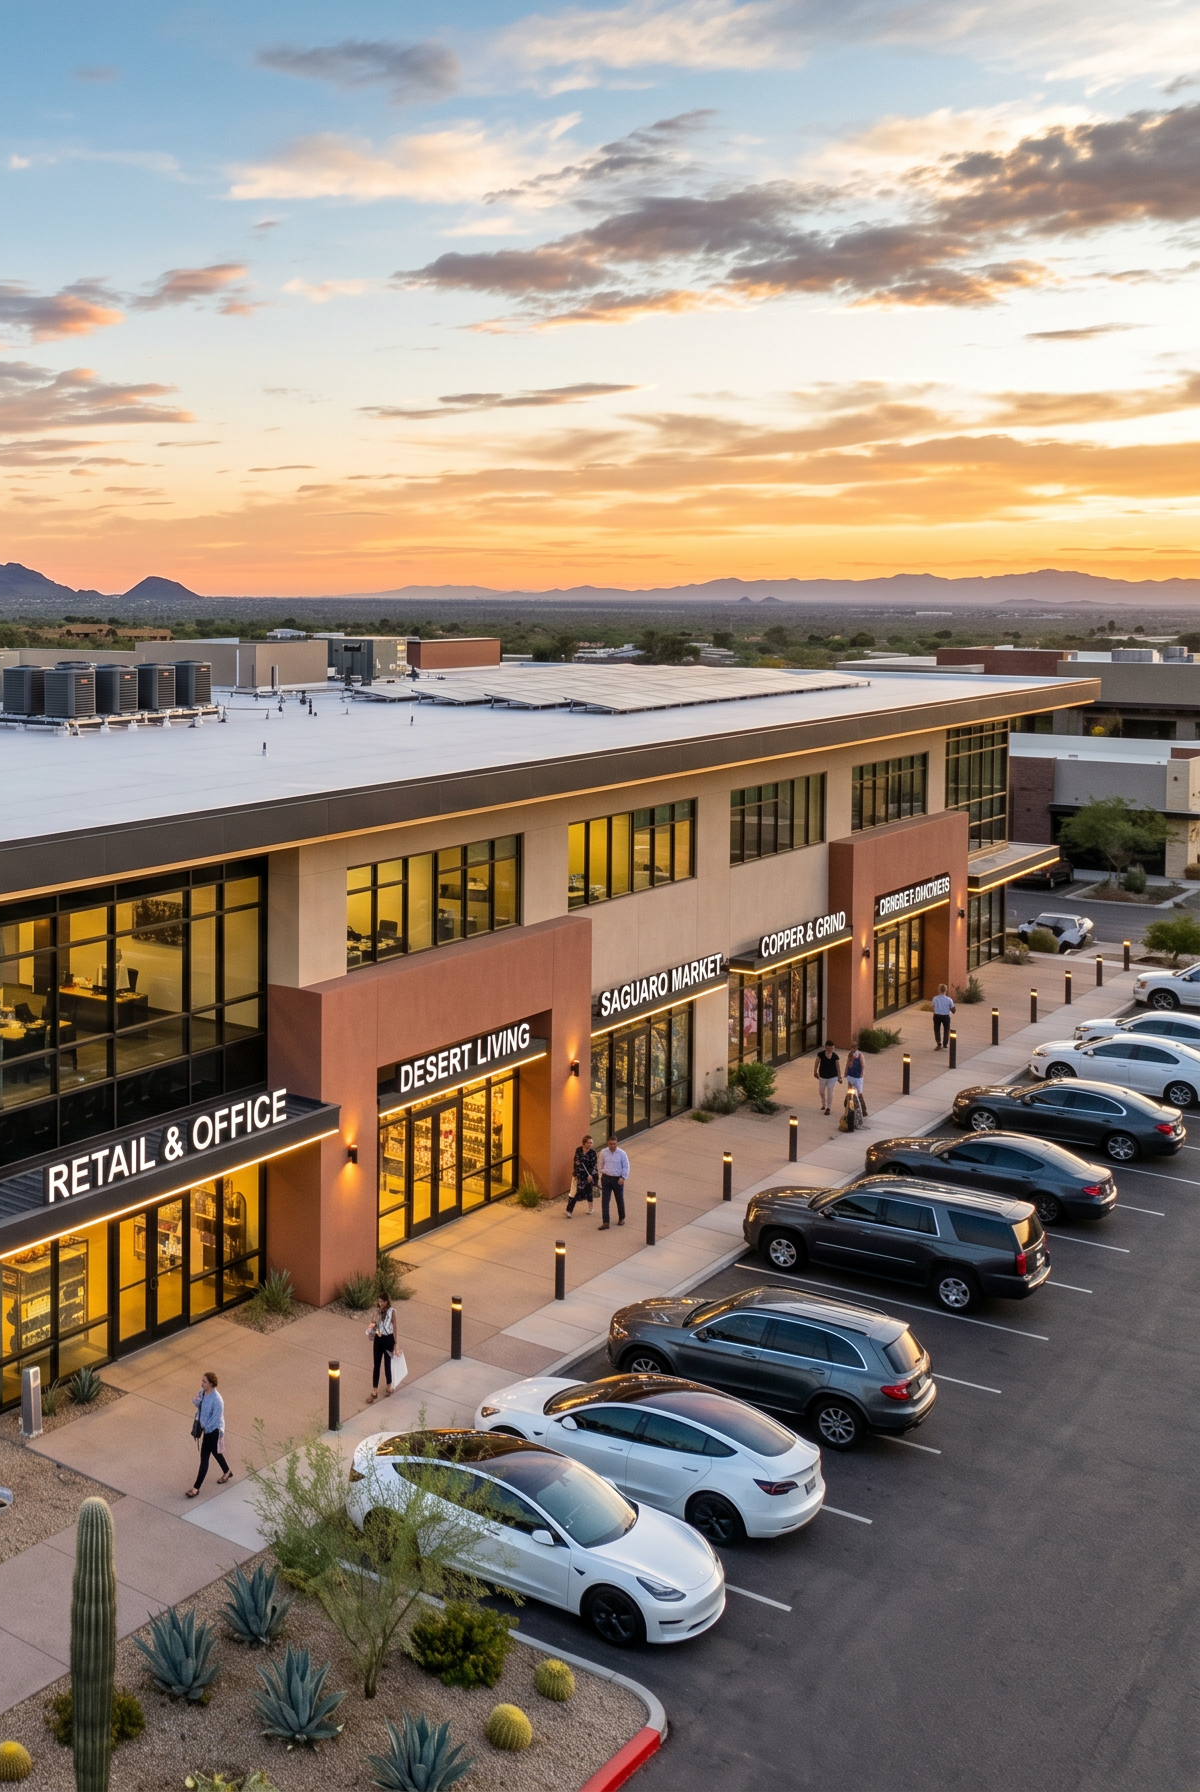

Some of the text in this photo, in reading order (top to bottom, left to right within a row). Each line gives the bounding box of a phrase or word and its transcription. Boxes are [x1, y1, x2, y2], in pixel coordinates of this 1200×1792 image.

[761, 911, 846, 958] COPPER & GRIND
[601, 953, 723, 1017] SAGUARO MARKET
[400, 1023, 530, 1093] DESERT LIVING
[48, 1088, 287, 1203] RETAIL & OFFICE
